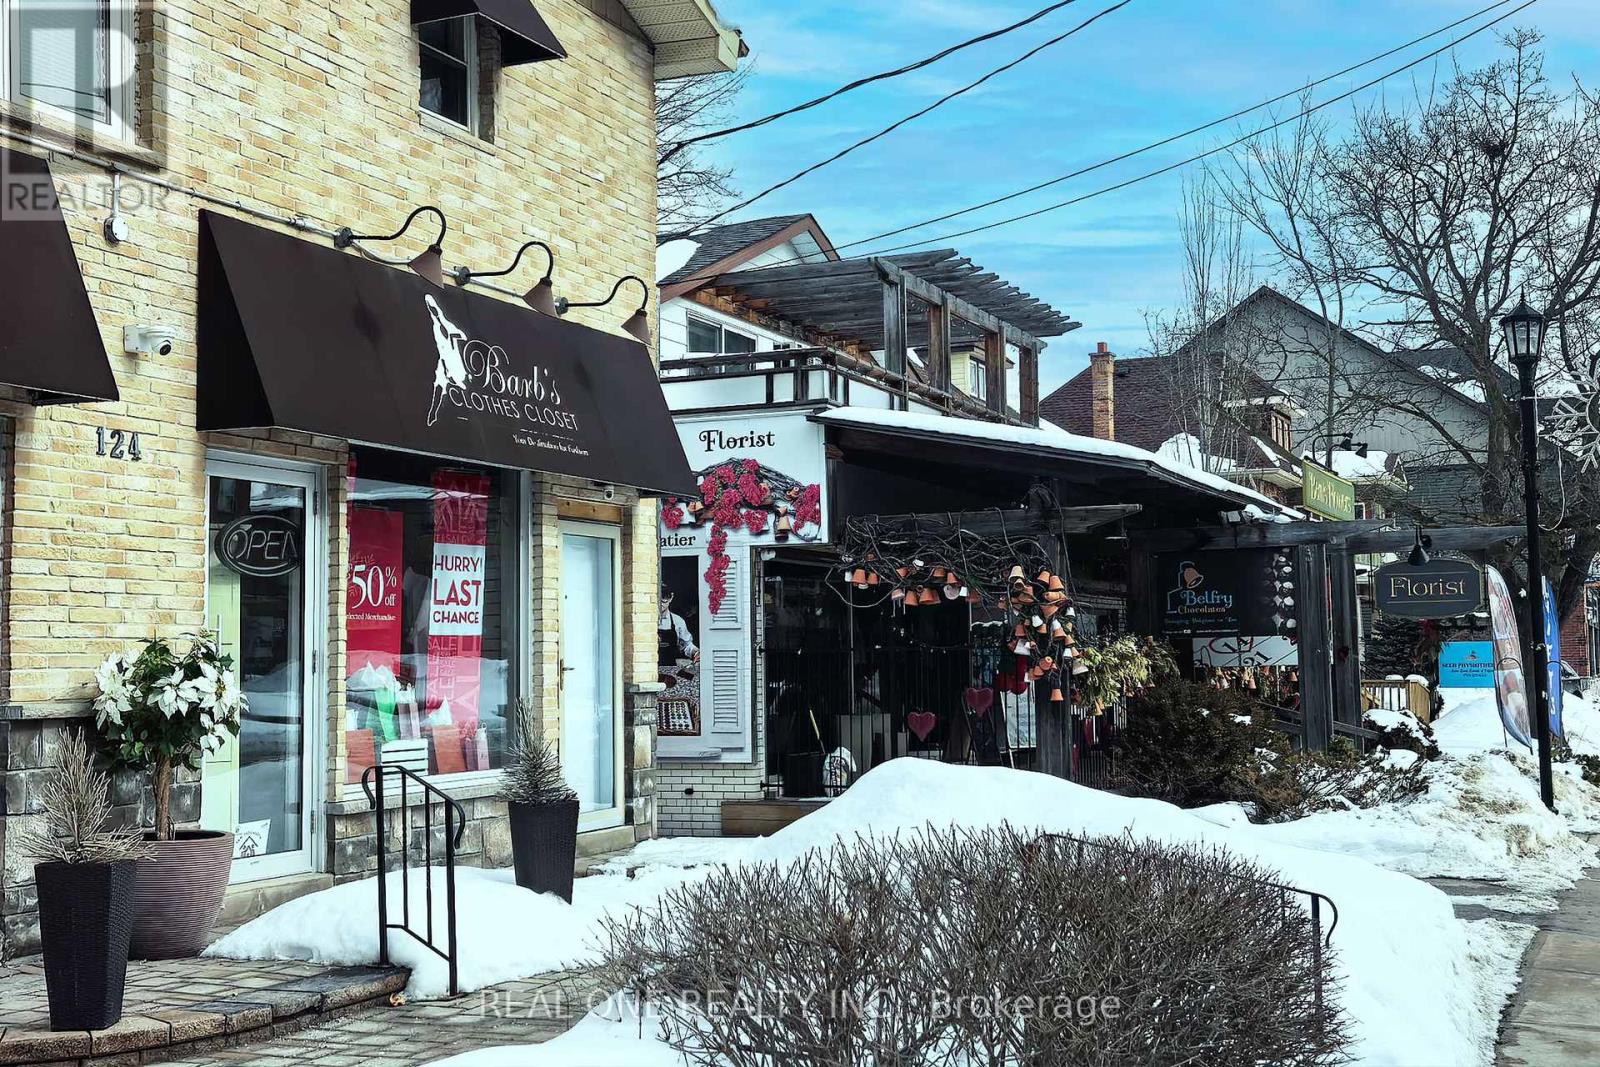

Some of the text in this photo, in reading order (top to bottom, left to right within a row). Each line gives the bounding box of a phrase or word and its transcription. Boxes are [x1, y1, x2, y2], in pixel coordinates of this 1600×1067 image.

[463, 340, 561, 405] Barb's
[448, 388, 579, 431] CLOTHES CLOSET
[95, 426, 142, 462] 124
[698, 429, 776, 452] Florist
[227, 528, 299, 560] OPEN
[434, 554, 483, 573] HURRY!
[433, 578, 482, 607] LAST
[1180, 590, 1233, 608] Belfry
[1390, 576, 1466, 598] Florist
[432, 610, 480, 625] CHANCE
